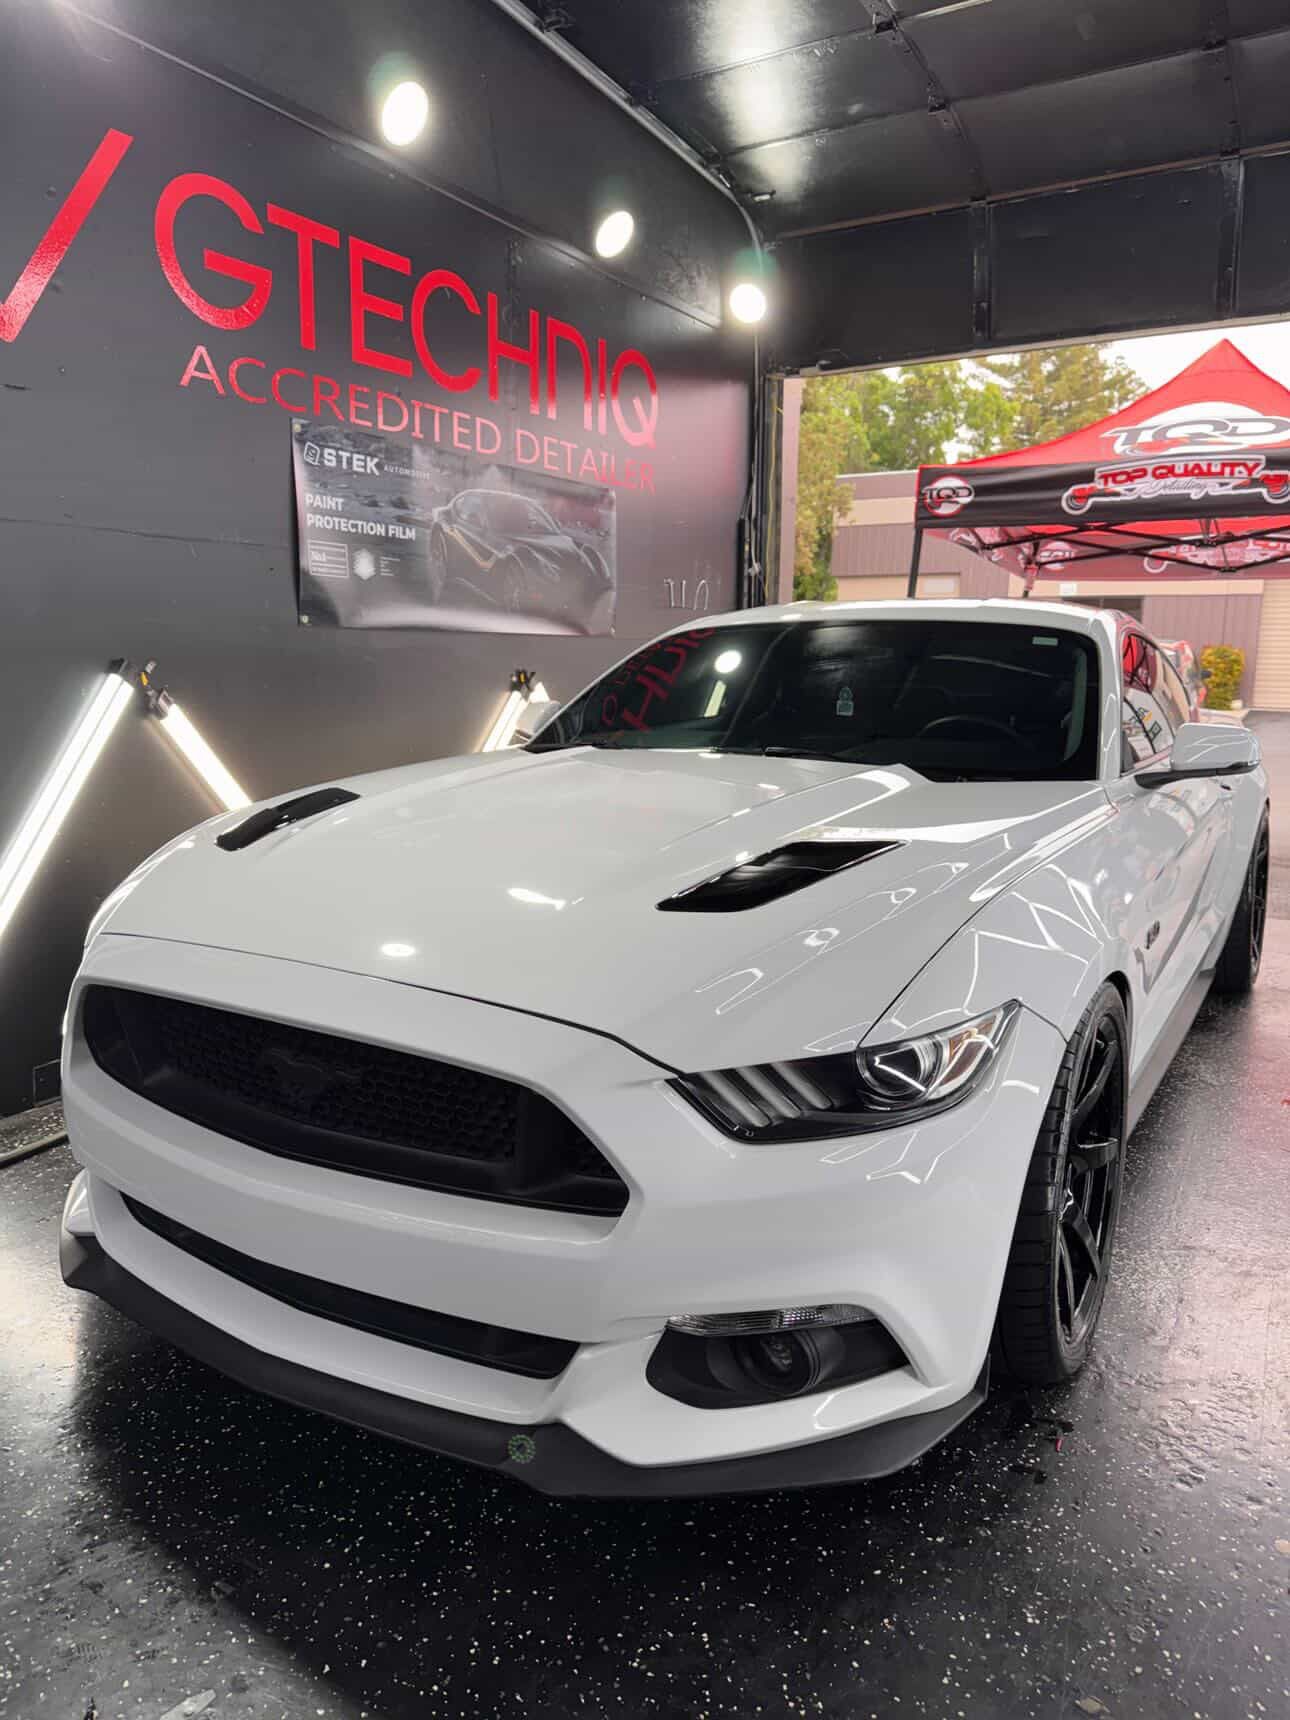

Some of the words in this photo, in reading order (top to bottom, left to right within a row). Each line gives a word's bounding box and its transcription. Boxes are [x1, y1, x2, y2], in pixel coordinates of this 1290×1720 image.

[154, 172, 659, 449] GTECHNIQ
[179, 344, 501, 454] ACCREDITED
[515, 428, 656, 494] DETAILER
[323, 447, 380, 476] STEK
[1098, 467, 1148, 487] TOP
[1151, 461, 1260, 481] QUALITY
[305, 493, 345, 512] PAINT
[306, 513, 386, 537] PROTECTION
[388, 524, 417, 541] FILM
